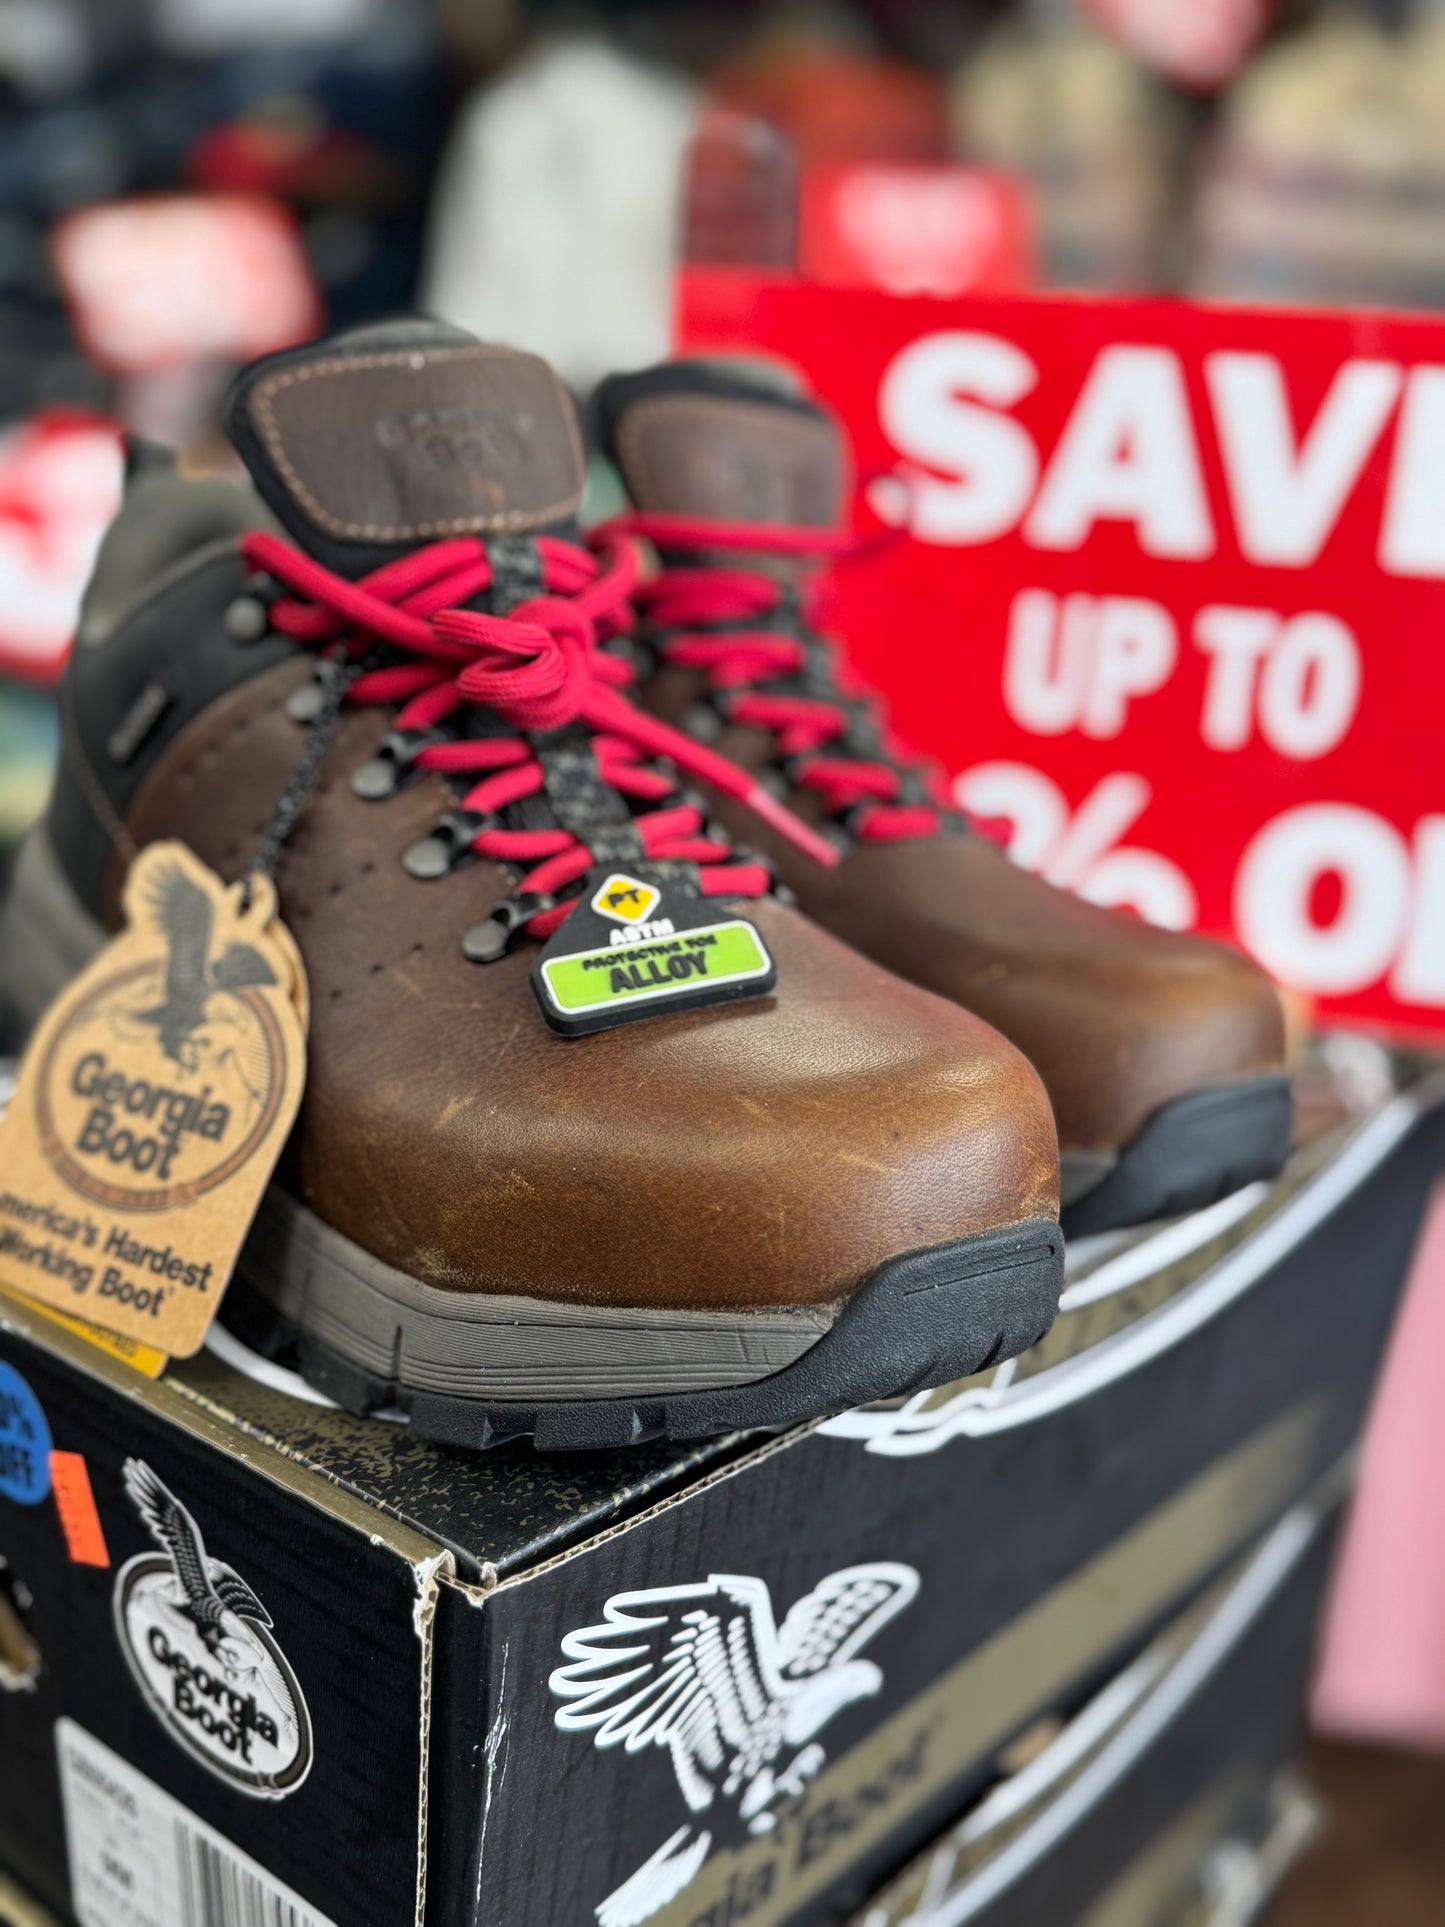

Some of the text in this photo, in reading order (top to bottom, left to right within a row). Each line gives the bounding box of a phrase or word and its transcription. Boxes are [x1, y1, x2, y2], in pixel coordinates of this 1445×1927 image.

[1004, 590, 1359, 759] UP TO
[610, 951, 709, 993] ALLOY
[71, 1053, 230, 1143] Georgia
[76, 1106, 179, 1180] Boot
[0, 1192, 212, 1292] merica's Hardest
[147, 1626, 279, 1750] Georgia
[173, 1676, 252, 1766] Boot
